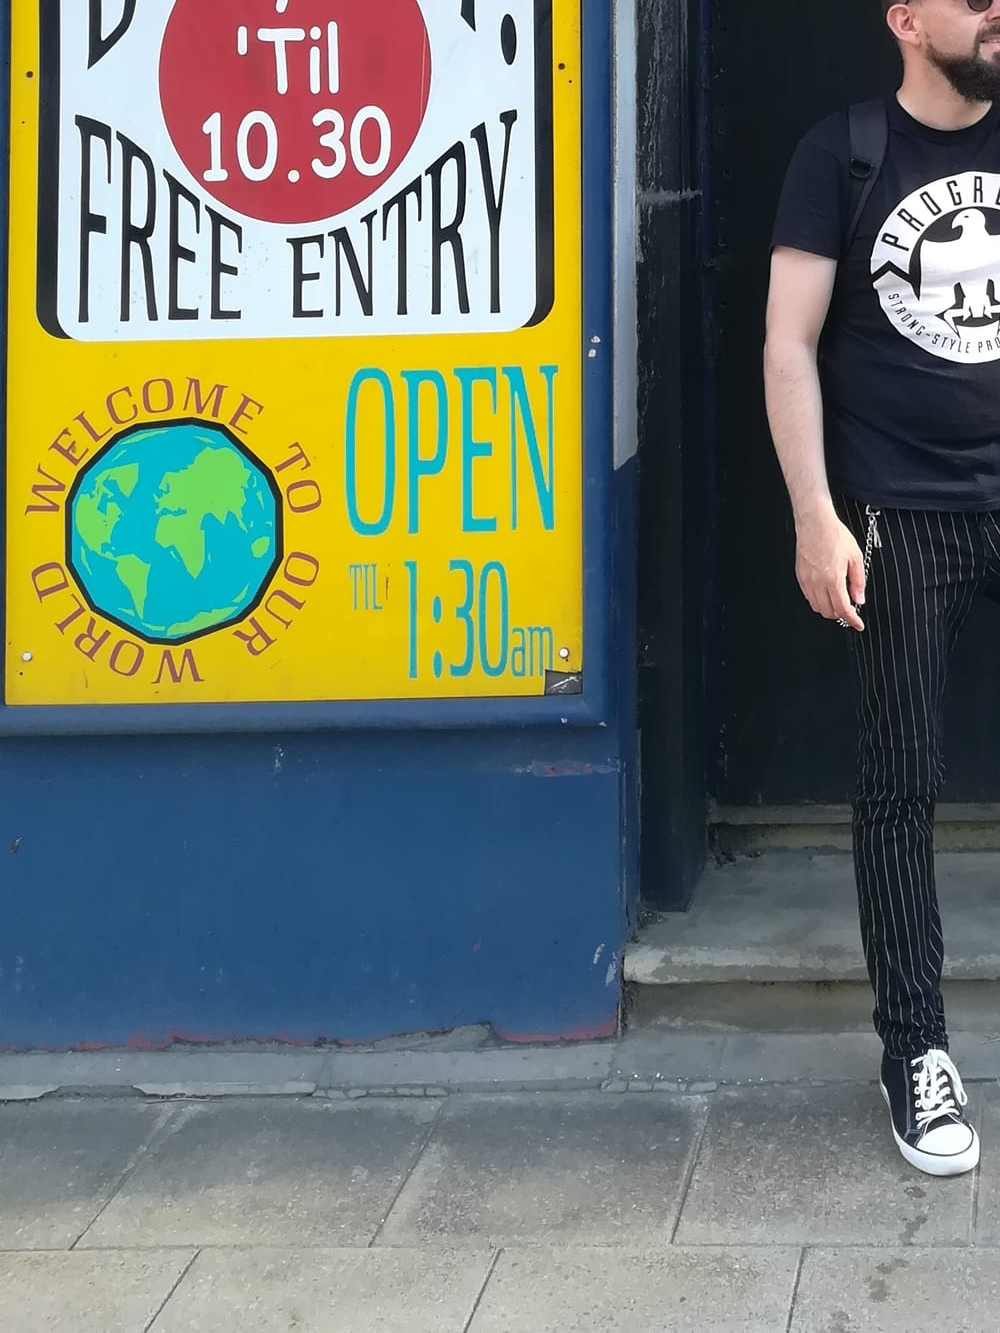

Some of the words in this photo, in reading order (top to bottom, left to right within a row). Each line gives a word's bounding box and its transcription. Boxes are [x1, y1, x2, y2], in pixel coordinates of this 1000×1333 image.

[237, 21, 339, 95] 'Til
[202, 105, 391, 183] 10.30
[75, 114, 242, 323] FREE
[286, 110, 517, 318] ENTRY
[888, 293, 970, 353] STRONG-STYLE
[977, 337, 1000, 353] PRO
[24, 377, 264, 516] WELCOME
[285, 442, 322, 514] TO
[345, 365, 558, 535] OPEN
[31, 561, 204, 684] WORLD
[233, 551, 319, 657] OUR
